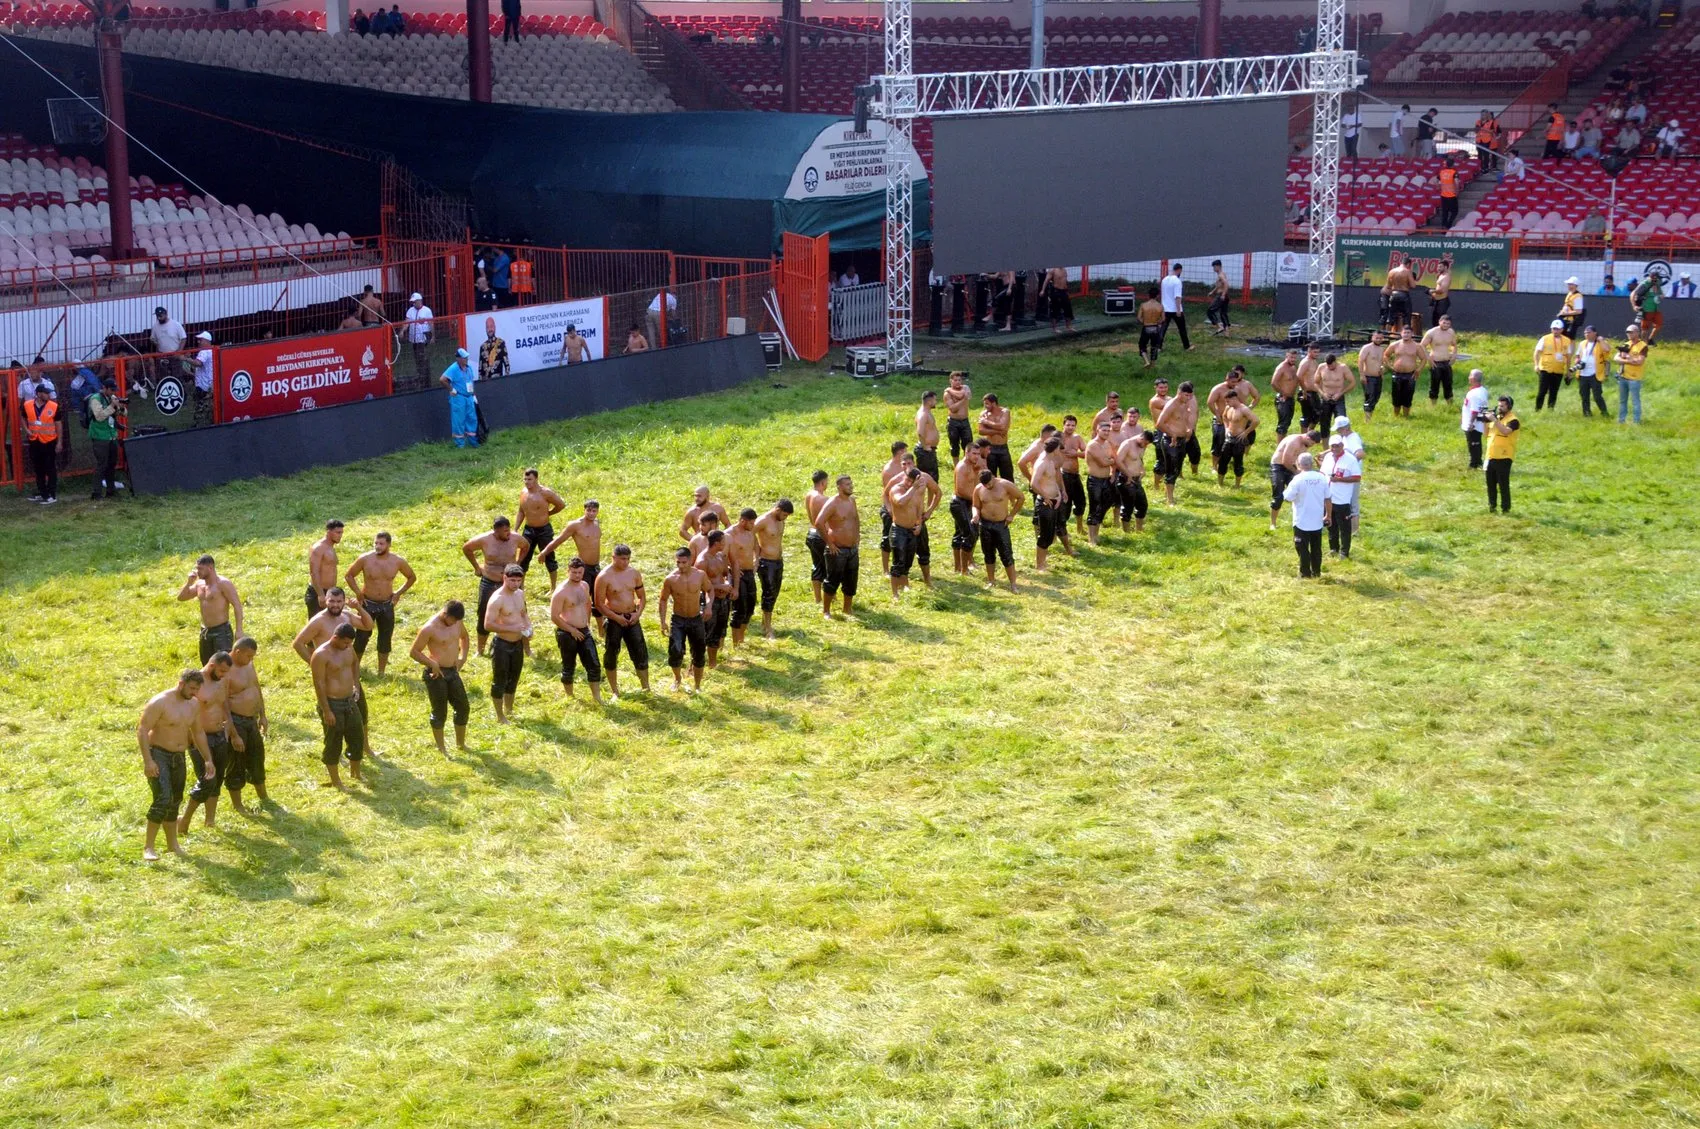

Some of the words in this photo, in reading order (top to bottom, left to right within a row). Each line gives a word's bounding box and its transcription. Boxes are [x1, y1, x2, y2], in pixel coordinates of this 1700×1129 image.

[829, 152, 836, 160] ER
[836, 150, 857, 159] MEYDANI
[825, 168, 863, 181] BAŞARILAR
[1341, 238, 1392, 247] KIRKPINAR'IN
[1393, 239, 1441, 249] DEĞİŞMEYEN
[1443, 240, 1459, 249] YAĞ
[1460, 242, 1504, 250] SPONSORU
[519, 316, 526, 324] ER
[559, 307, 590, 318] KAHRAMANI
[527, 323, 538, 332] TÜM
[516, 333, 562, 349] BAŞARILAR
[266, 365, 275, 374] ER
[275, 361, 305, 373] MEYDANI
[305, 355, 345, 369] KIRKPINAR'A
[261, 379, 289, 398] HOŞ
[290, 366, 351, 392] GELDİNİZ
